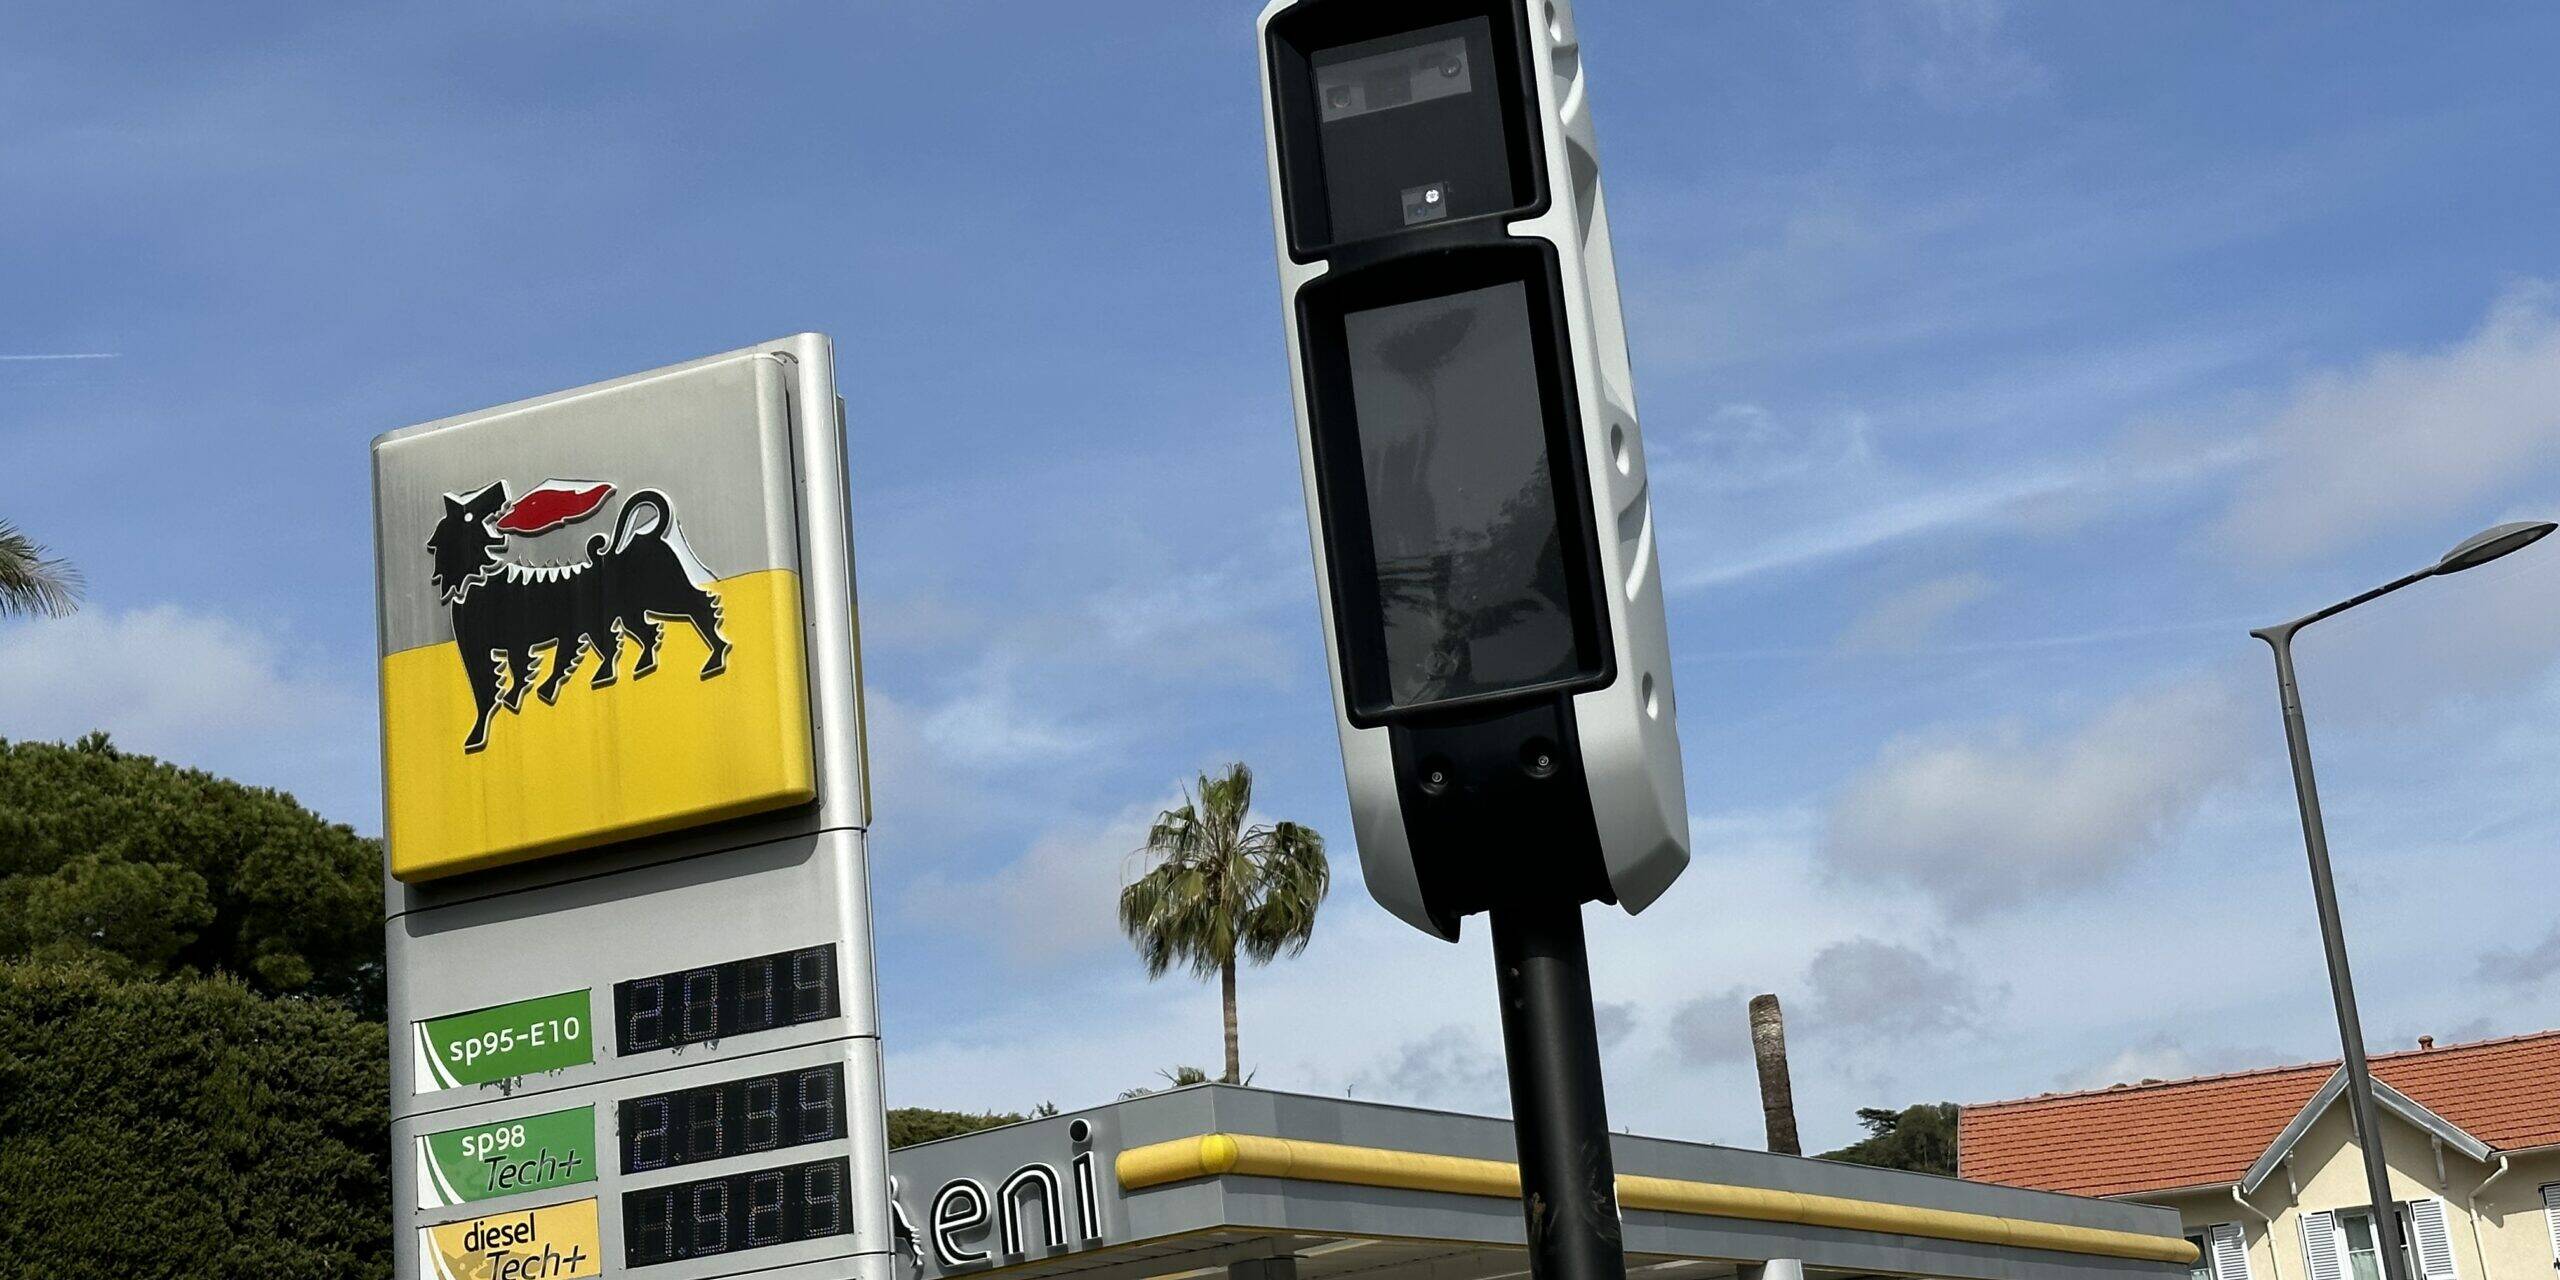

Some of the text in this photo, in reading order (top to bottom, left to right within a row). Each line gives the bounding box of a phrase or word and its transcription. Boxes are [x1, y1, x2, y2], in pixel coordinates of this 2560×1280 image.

[450, 1016, 580, 1066] sp95-E10
[461, 1124, 526, 1162] sp98
[484, 1148, 582, 1192] Tech+
[929, 1118, 1102, 1268] eni
[463, 1211, 536, 1253] diesel
[486, 1242, 587, 1280] Tech+
